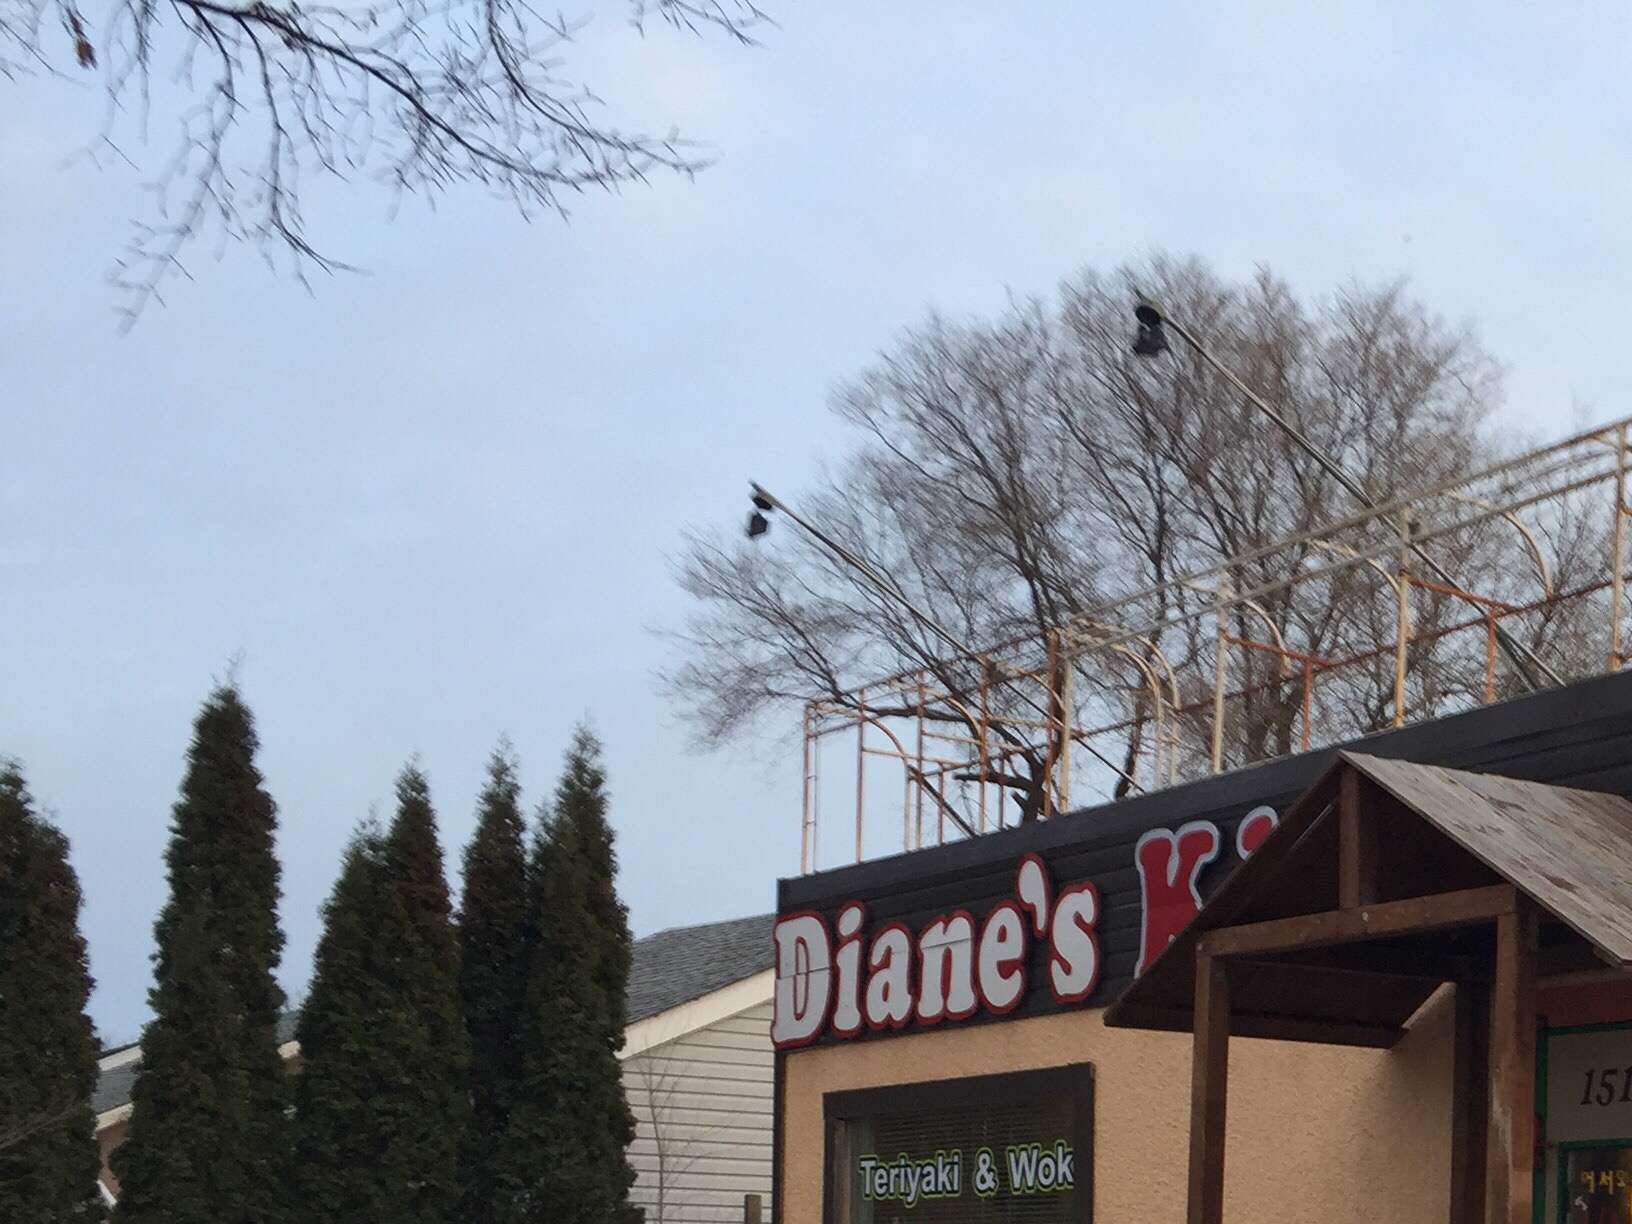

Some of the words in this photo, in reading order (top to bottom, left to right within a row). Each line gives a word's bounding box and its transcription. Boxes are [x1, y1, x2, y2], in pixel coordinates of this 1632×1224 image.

[771, 853, 1098, 1048] Diane's
[860, 1150, 961, 1208] Teriyaki
[973, 1147, 998, 1196] &
[1006, 1140, 1074, 1195] Wok
